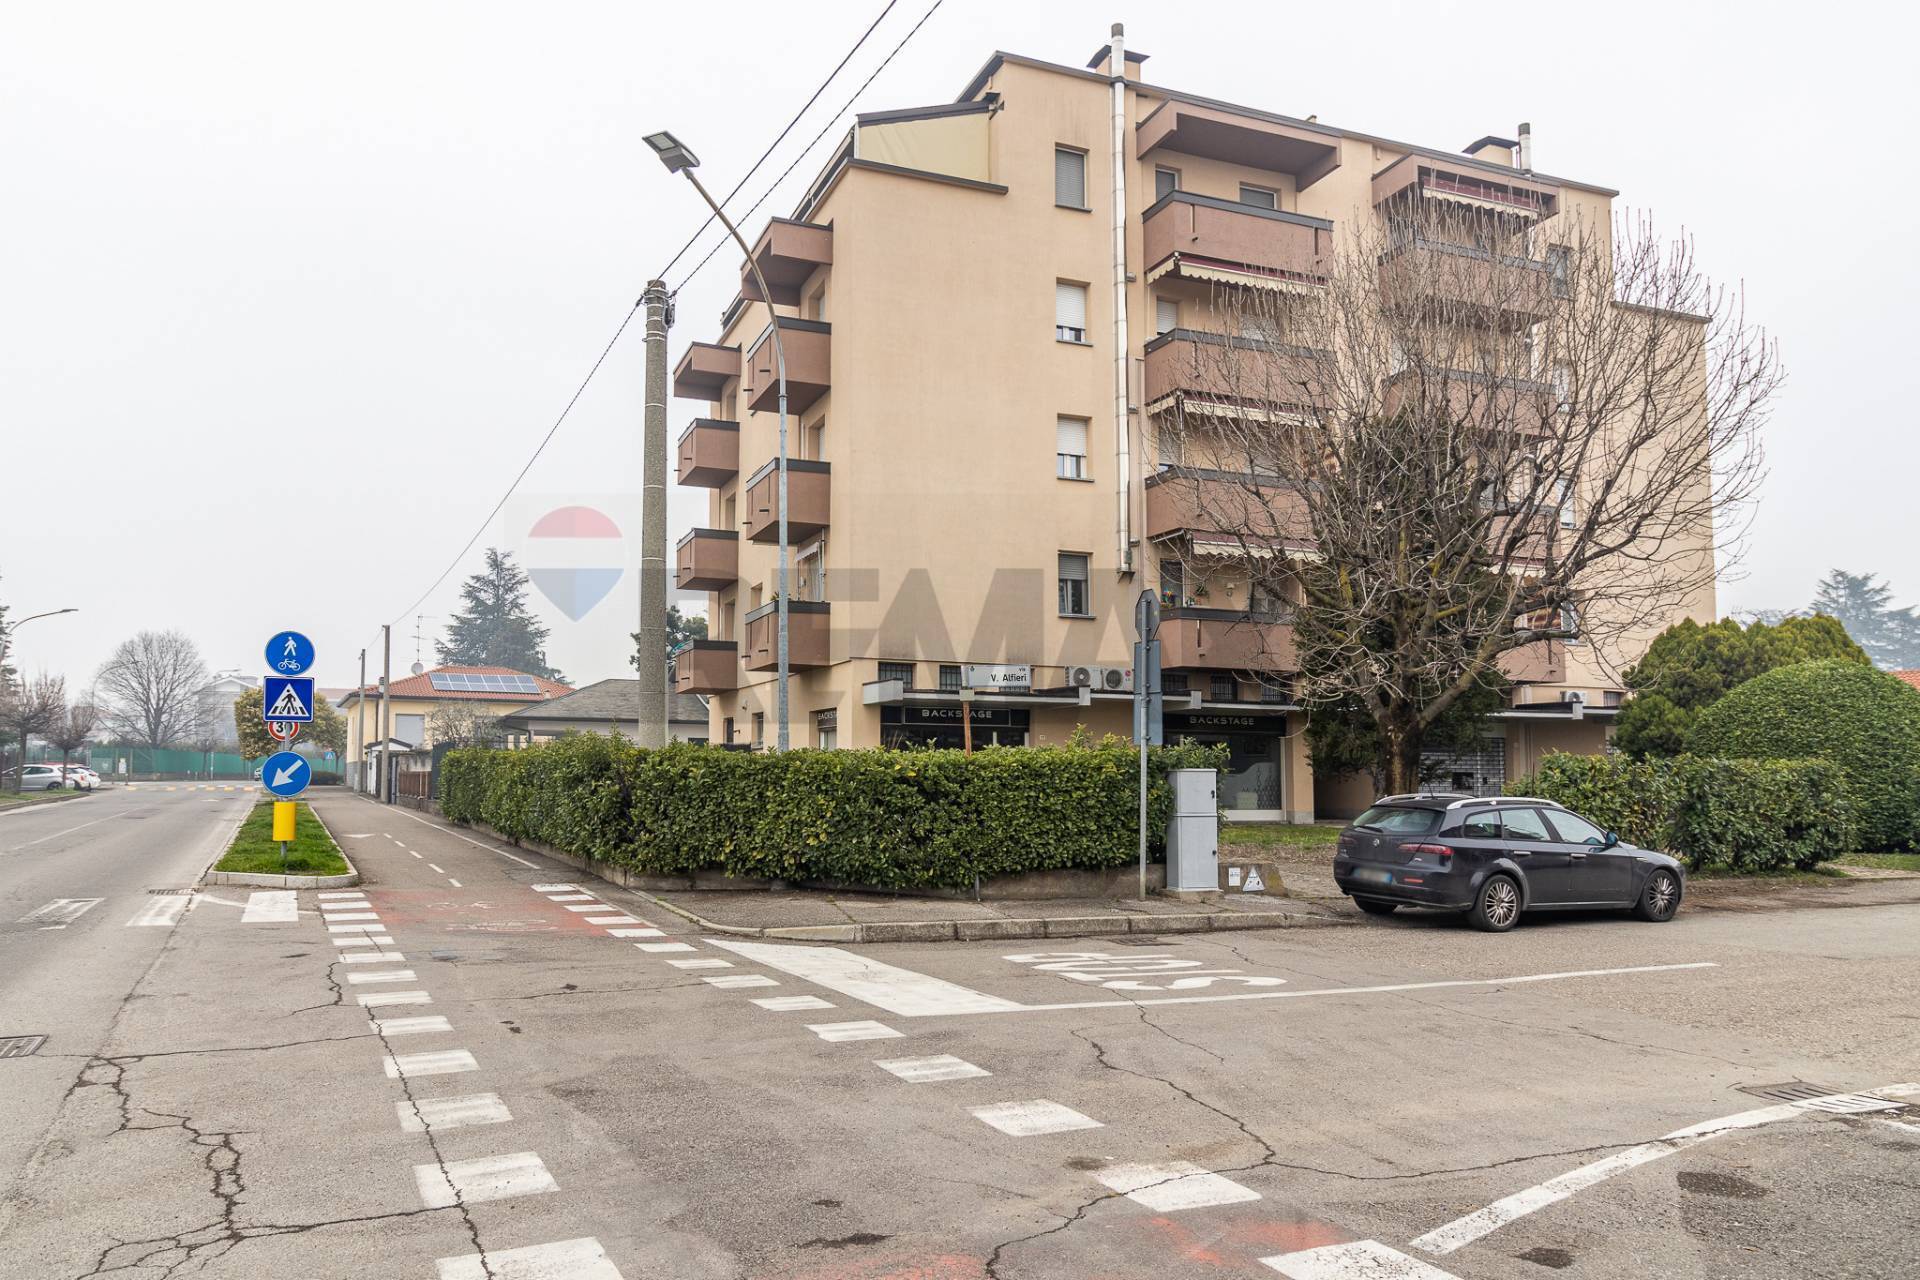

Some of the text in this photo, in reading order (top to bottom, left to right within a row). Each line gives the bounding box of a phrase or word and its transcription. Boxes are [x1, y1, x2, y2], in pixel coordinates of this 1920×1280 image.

[990, 673, 1027, 682] V. Alfieri
[921, 709, 993, 718] BACKSAGE
[1189, 716, 1255, 725] BACKSTAGE
